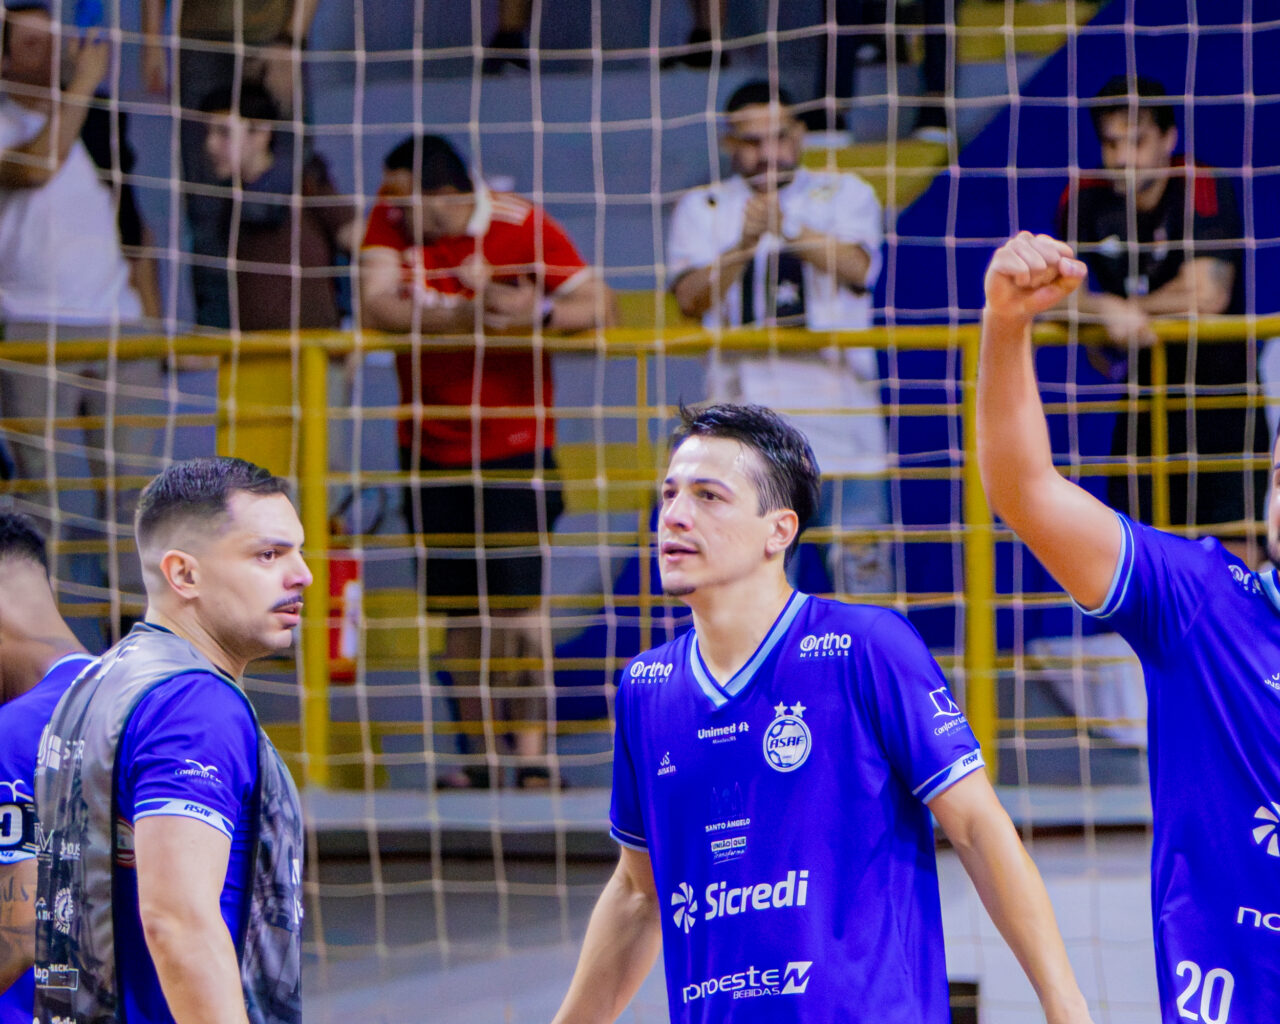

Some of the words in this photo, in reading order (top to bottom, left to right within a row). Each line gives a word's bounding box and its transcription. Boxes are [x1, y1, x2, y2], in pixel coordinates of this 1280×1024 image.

[799, 633, 851, 652] Ortho
[697, 723, 736, 739] Unimed
[769, 735, 805, 749] ASAF
[705, 822, 726, 832] SANTO
[705, 870, 809, 920] Sicredi
[733, 987, 780, 999] BEBIDAS
